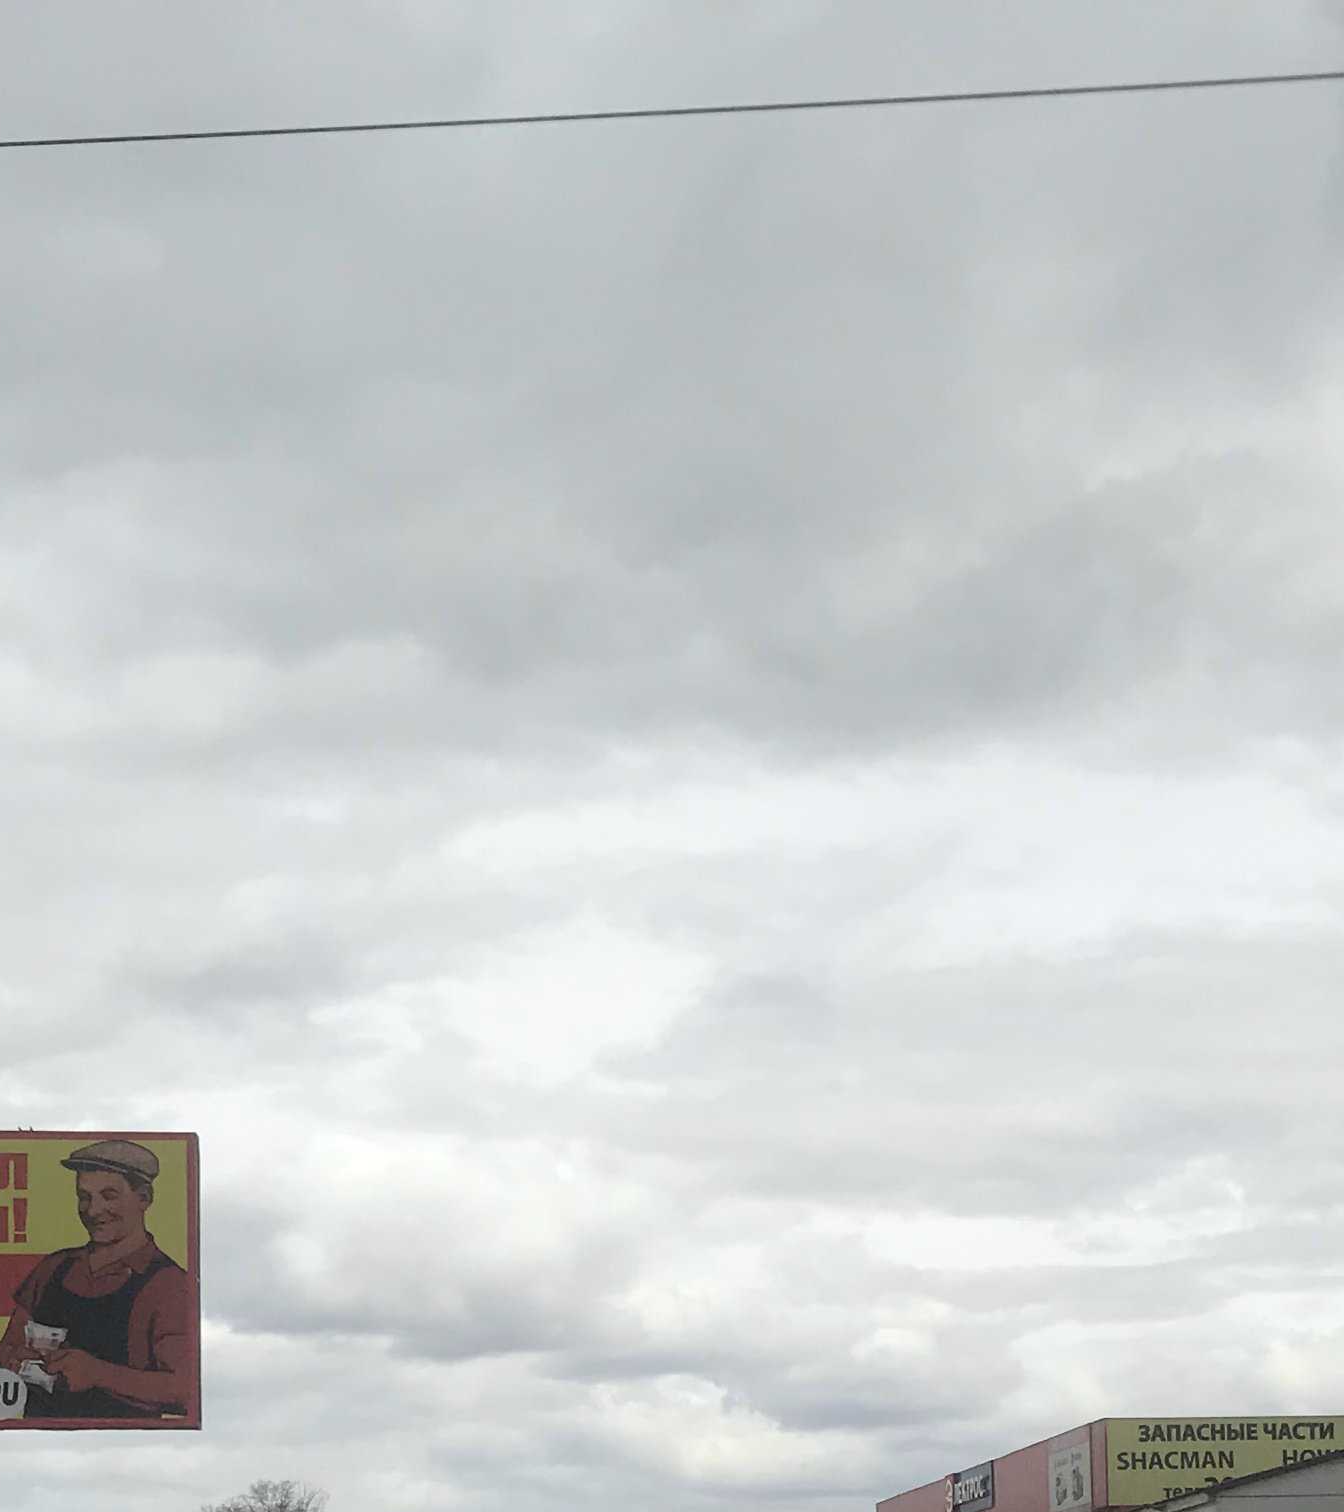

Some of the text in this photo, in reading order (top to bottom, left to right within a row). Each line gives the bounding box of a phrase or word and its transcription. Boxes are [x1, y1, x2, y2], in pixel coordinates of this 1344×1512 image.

[1138, 1422, 1335, 1442] ЗАПАСНЫЕ ЧАСТИ
[1117, 1450, 1234, 1470] SHACMAN
